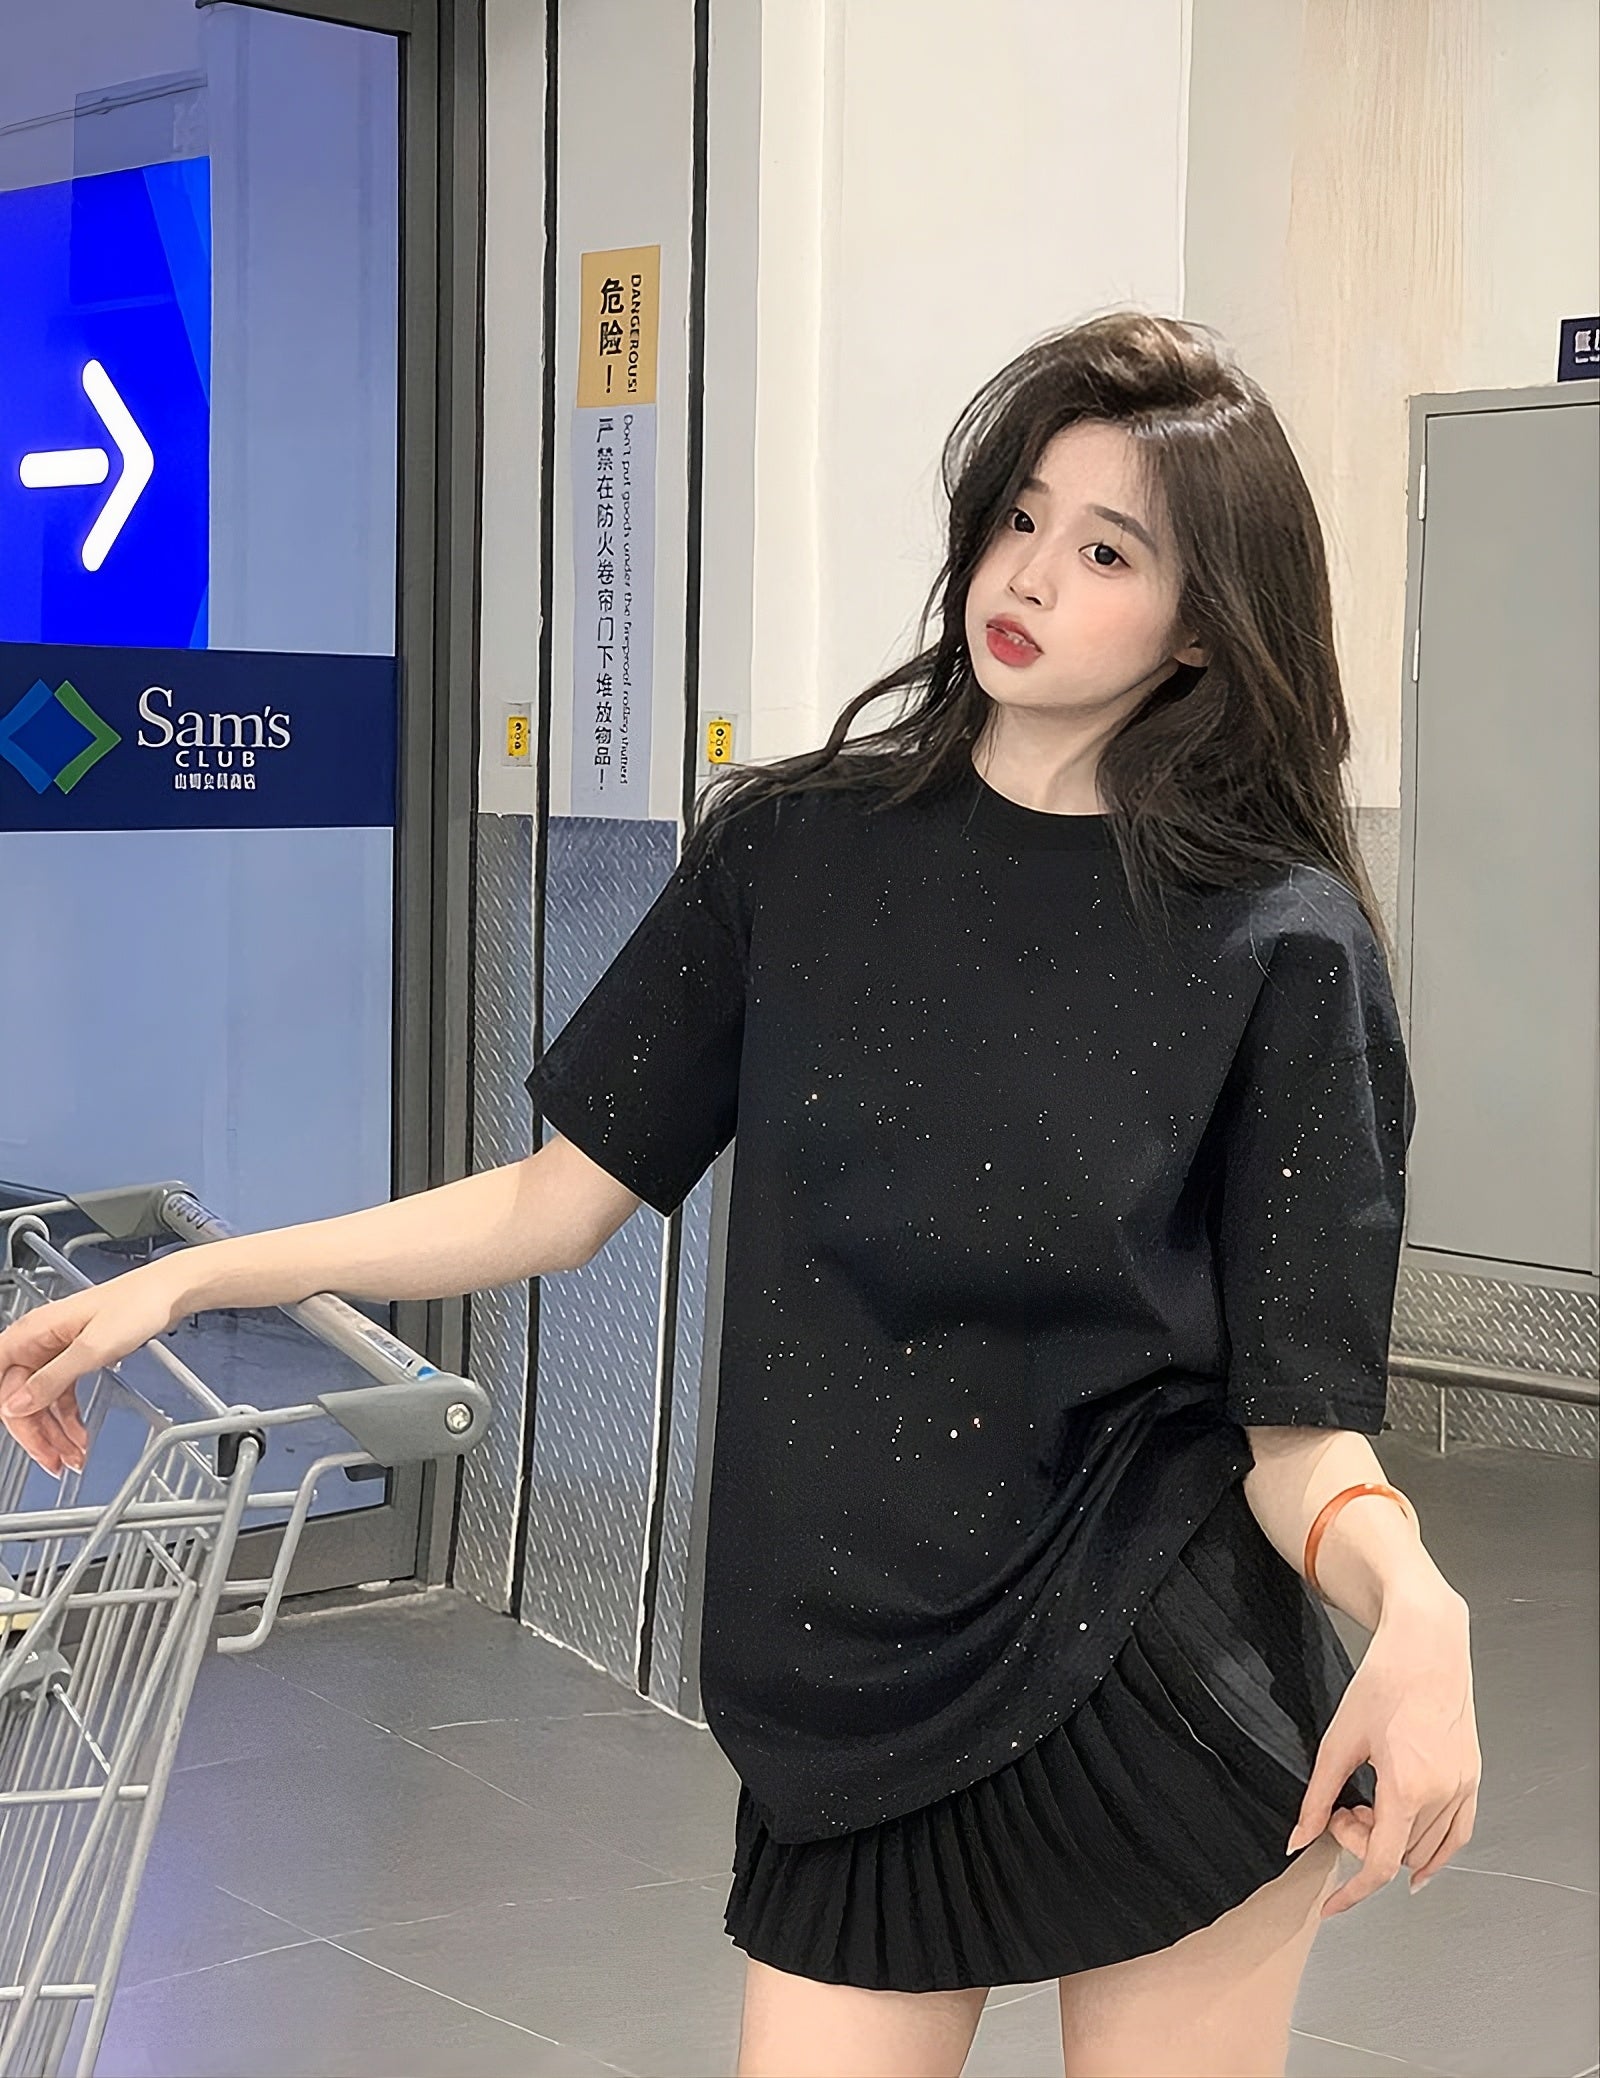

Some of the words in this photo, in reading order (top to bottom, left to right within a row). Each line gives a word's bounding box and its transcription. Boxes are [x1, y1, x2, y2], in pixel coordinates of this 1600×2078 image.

[600, 277, 624, 393] 危险！
[138, 686, 291, 749] Sam's
[175, 750, 256, 768] CLUB
